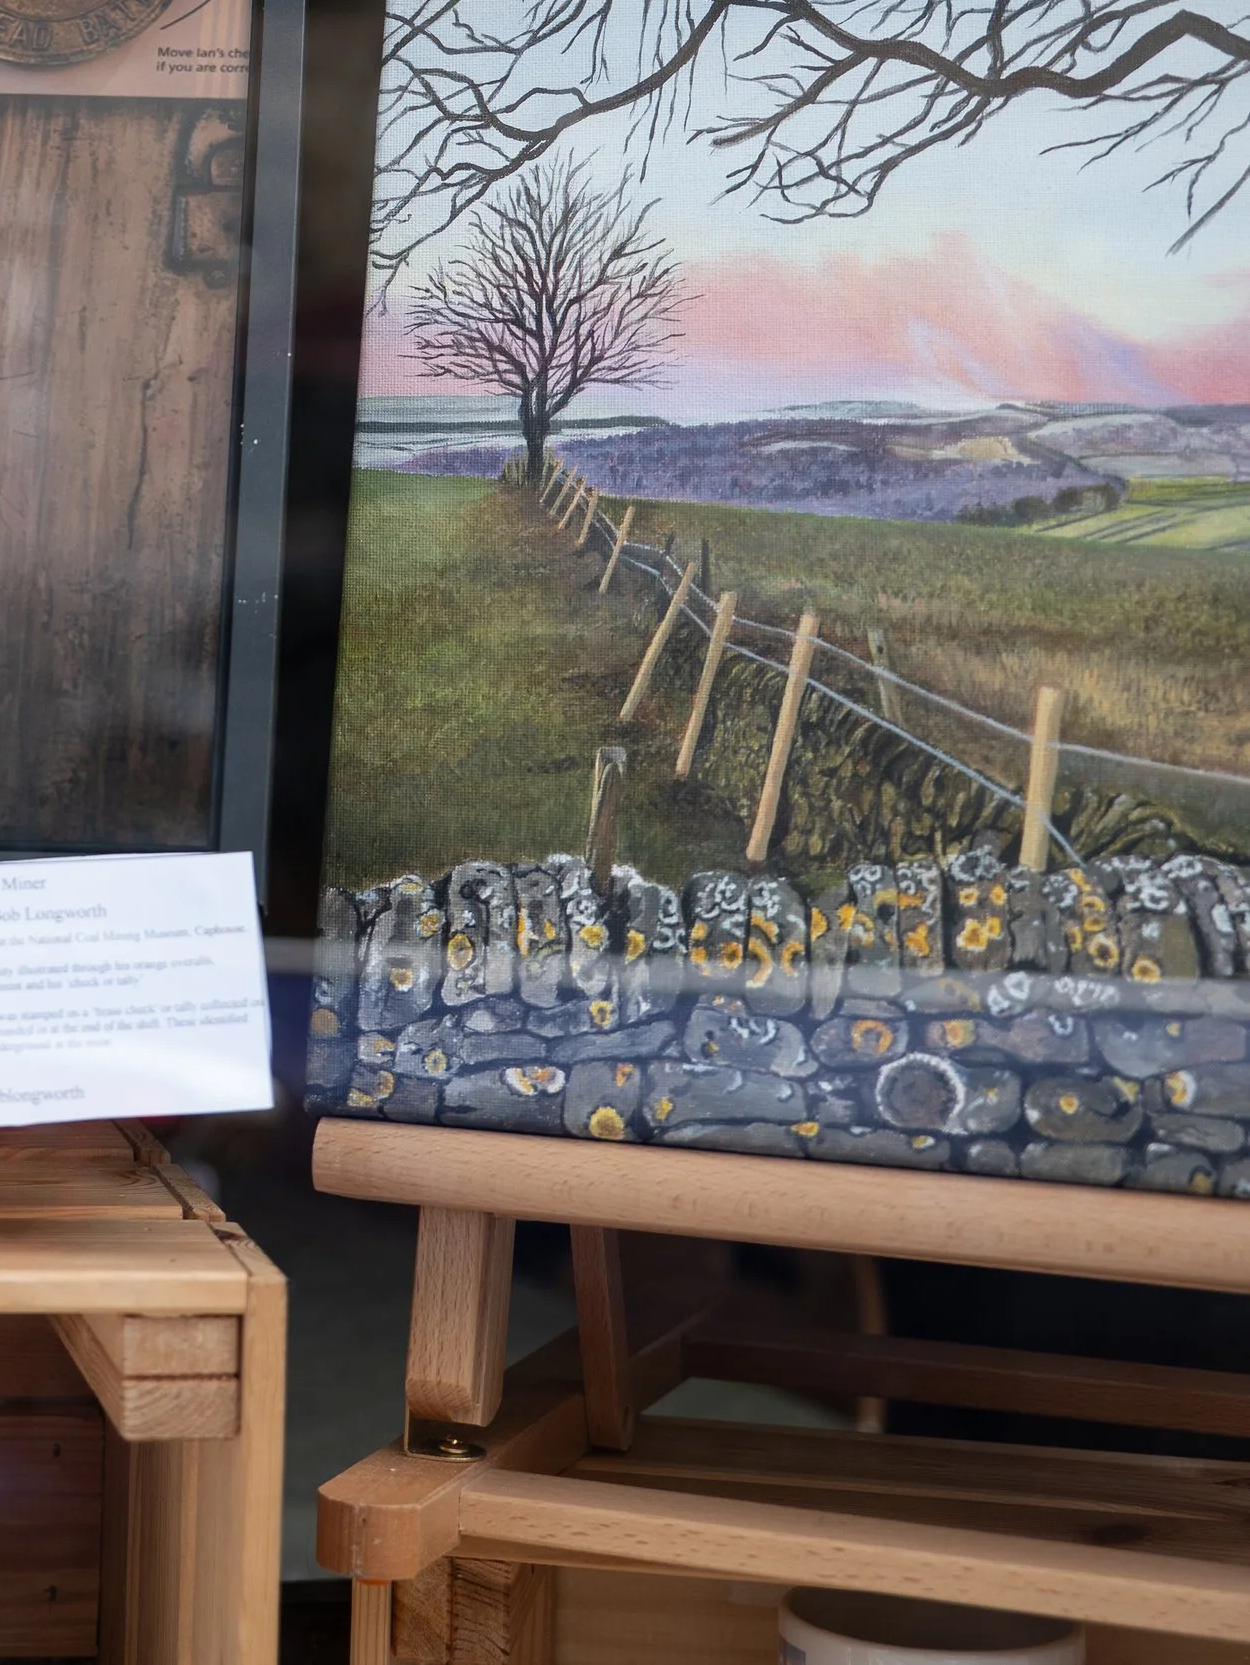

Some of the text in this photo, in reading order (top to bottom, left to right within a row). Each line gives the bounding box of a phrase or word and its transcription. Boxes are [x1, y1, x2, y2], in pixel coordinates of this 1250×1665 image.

[157, 47, 193, 57] Move
[196, 48, 225, 58] Ian's
[156, 61, 166, 71] if
[169, 63, 193, 75] you
[196, 64, 216, 72] are
[2, 877, 46, 890] Miner
[25, 903, 107, 922] Longworth
